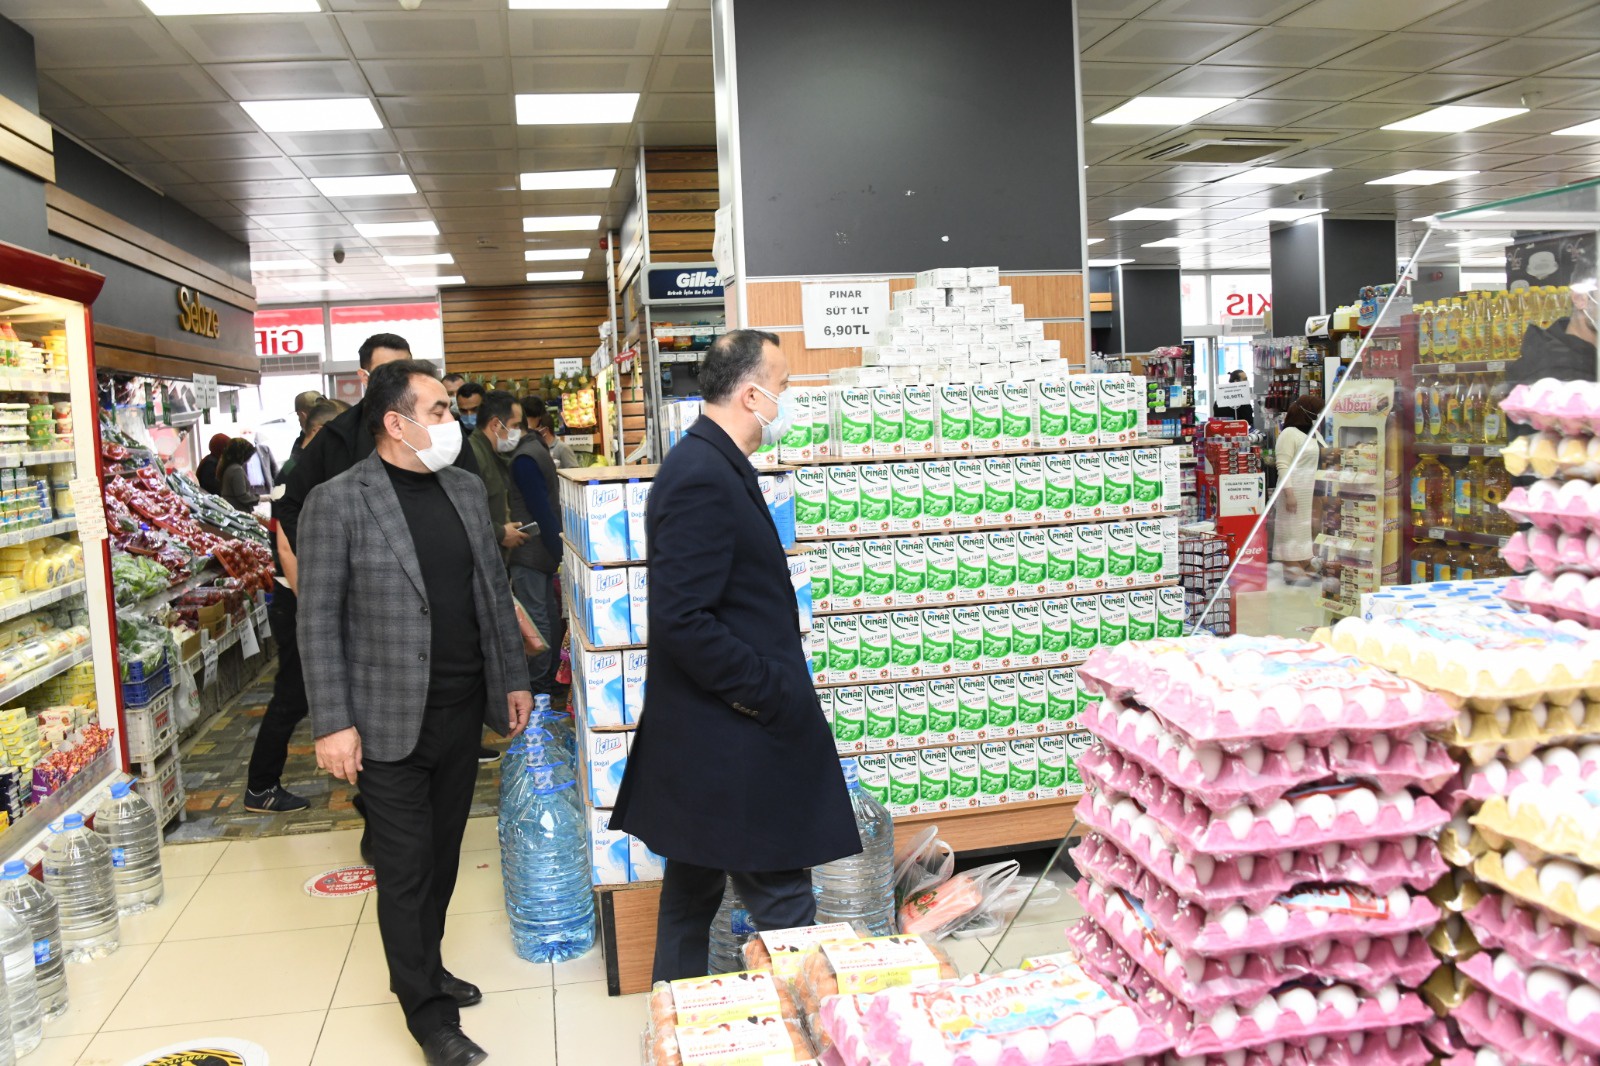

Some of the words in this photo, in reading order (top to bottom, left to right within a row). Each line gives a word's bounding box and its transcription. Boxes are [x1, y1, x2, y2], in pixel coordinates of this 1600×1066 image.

[676, 271, 724, 288] Gillet
[829, 290, 862, 298] PINAR
[178, 286, 220, 339] Sebze
[826, 306, 847, 316] SÜT
[851, 306, 870, 314] 1LT
[824, 324, 870, 338] 6,90TL
[1044, 384, 1065, 393] PINAR
[1074, 383, 1094, 392] PINAR
[1105, 381, 1124, 390] PINAR
[909, 390, 931, 398] PINAR
[946, 388, 967, 397] PINAR
[977, 387, 998, 396] PINAR
[1006, 386, 1027, 395] PINAR
[847, 392, 868, 401] PINAR
[878, 392, 901, 400] PINAR
[1079, 456, 1099, 464] PINAR
[1108, 454, 1128, 462] PINAR
[1137, 452, 1156, 460] PINAR
[959, 462, 981, 471] PINAR
[989, 461, 1011, 470] PINAR
[1020, 460, 1041, 468] PINAR
[1050, 458, 1071, 466] PINAR
[865, 468, 887, 476] PINAR
[896, 466, 919, 475] PINAR
[928, 464, 950, 473] PINAR
[800, 471, 824, 480] PINAR
[833, 470, 856, 478] PINAR
[1081, 528, 1103, 536] PINAR
[1112, 526, 1132, 534] PINAR
[1140, 523, 1160, 532] PINAR
[1023, 533, 1044, 542] PINAR
[1052, 530, 1072, 539] PINAR
[931, 540, 954, 548] PINAR
[962, 537, 984, 546] PINAR
[993, 535, 1014, 544] PINAR
[837, 545, 860, 553] PINAR
[868, 542, 892, 551] PINAR
[901, 542, 923, 550] PINAR
[1104, 596, 1124, 604] PINAR
[1133, 594, 1152, 602] PINAR
[1163, 591, 1182, 600] PINAR
[1047, 602, 1067, 610] PINAR
[1076, 598, 1096, 607] PINAR
[988, 607, 1009, 616] PINAR
[1017, 605, 1037, 613] PINAR
[896, 614, 918, 623] PINAR
[927, 612, 949, 621] PINAR
[958, 610, 979, 618] PINAR
[833, 619, 856, 627] PINAR
[865, 616, 887, 625] PINAR
[1023, 674, 1043, 682] PINAR
[1052, 670, 1073, 679] PINAR
[964, 679, 985, 688] PINAR
[994, 677, 1014, 685] PINAR
[903, 684, 924, 693] PINAR
[933, 682, 955, 690] PINAR
[840, 690, 862, 698] PINAR
[871, 687, 893, 696] PINAR
[1043, 738, 1063, 746] PINAR
[1071, 734, 1091, 743] PINAR
[985, 745, 1005, 753] PINAR
[1013, 741, 1034, 749] PINAR
[925, 751, 945, 759] PINAR
[954, 748, 975, 756] PINAR
[863, 757, 885, 766] PINAR
[894, 754, 916, 762] PINAR
